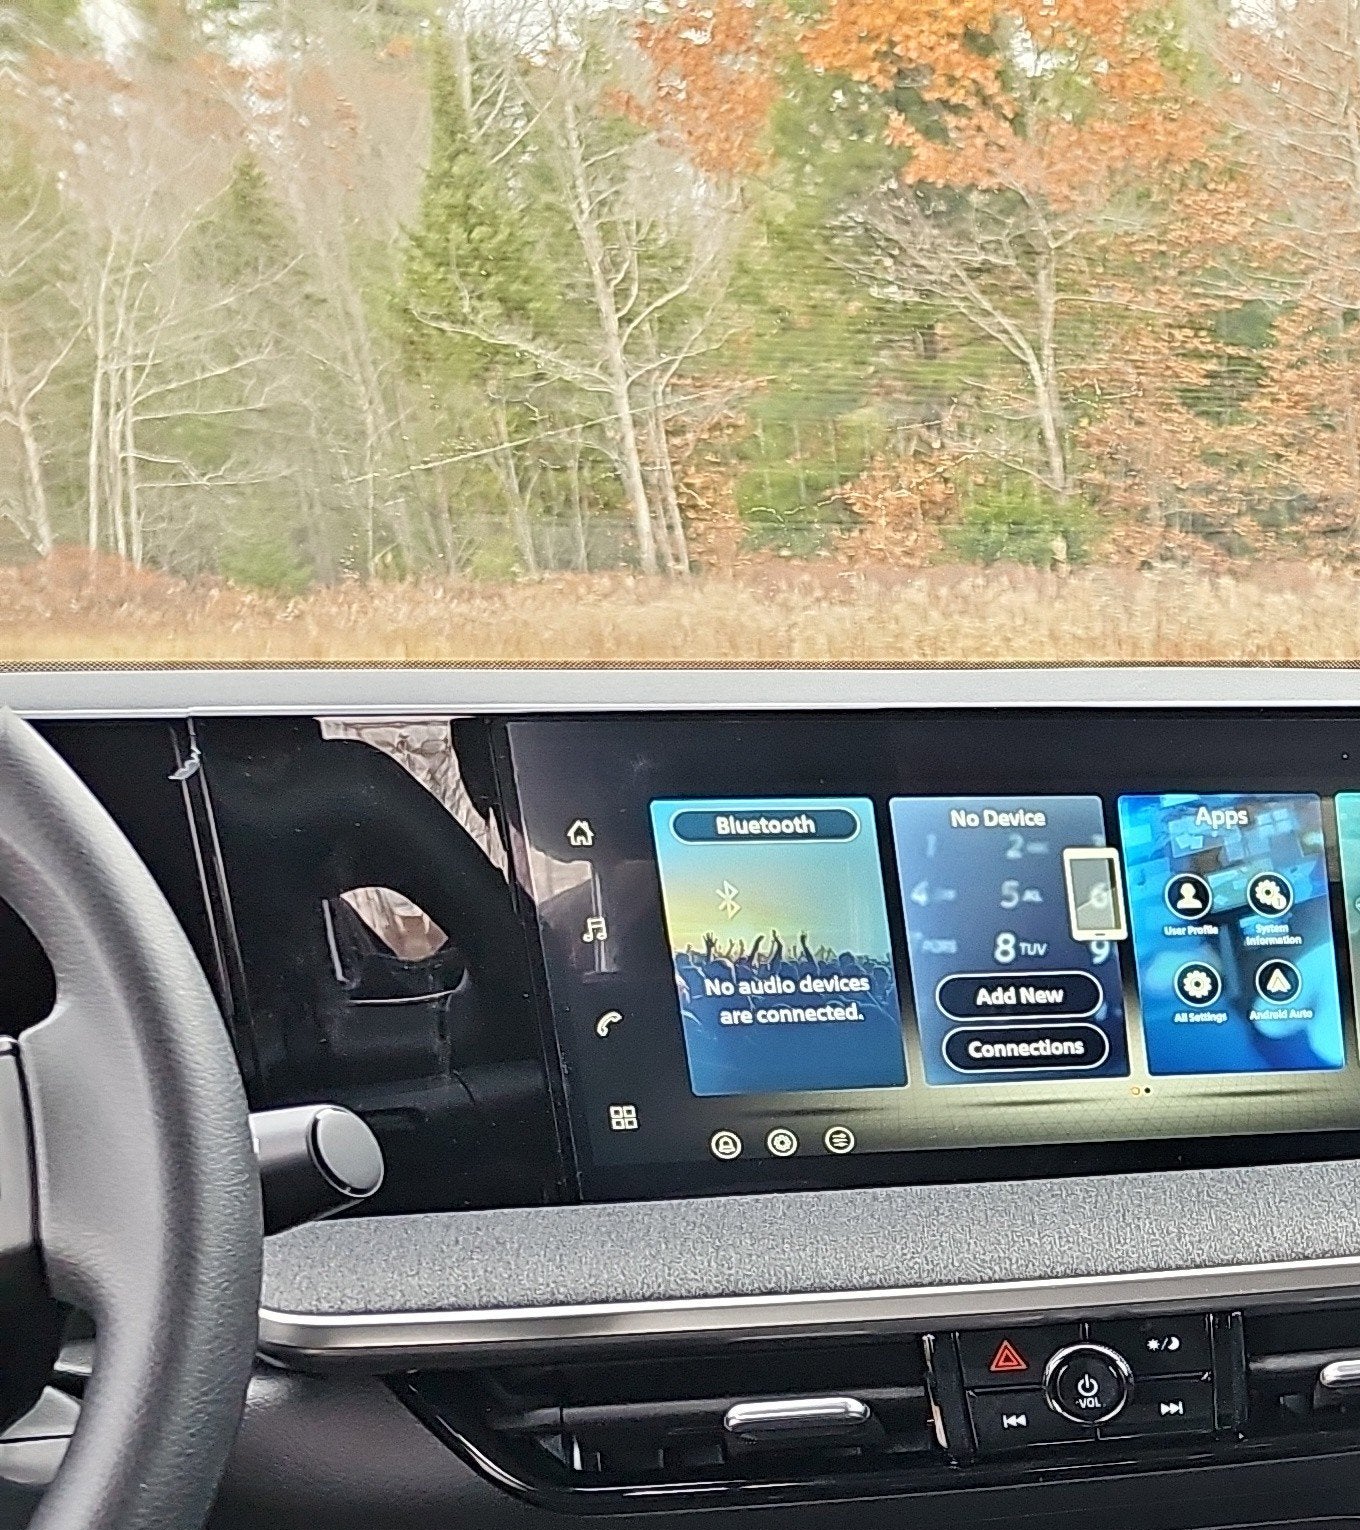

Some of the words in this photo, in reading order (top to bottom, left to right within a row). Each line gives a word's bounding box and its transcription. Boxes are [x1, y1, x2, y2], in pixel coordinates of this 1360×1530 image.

[716, 814, 816, 835] Bluetooth
[950, 809, 979, 828] No
[983, 809, 1047, 828] Device
[1195, 807, 1248, 829] Apps
[1000, 880, 1021, 909] 5
[1164, 926, 1186, 936] User
[1187, 925, 1219, 936] Profile
[1255, 924, 1289, 936] System
[994, 932, 1017, 963] 8
[1019, 942, 1047, 955] TUV
[1246, 935, 1303, 946] Information
[704, 978, 735, 996] No
[738, 975, 796, 995] audio
[799, 974, 870, 994] devices
[976, 986, 1018, 1006] Add
[1020, 986, 1064, 1005] New
[720, 1009, 753, 1025] are
[756, 1002, 865, 1025] connected.
[1174, 1013, 1188, 1023] All
[1189, 1012, 1228, 1023] Settings
[1250, 1010, 1289, 1020] Android
[1290, 1009, 1313, 1019] Auto
[968, 1039, 1085, 1060] Connections
[1079, 1397, 1101, 1410] VOL
